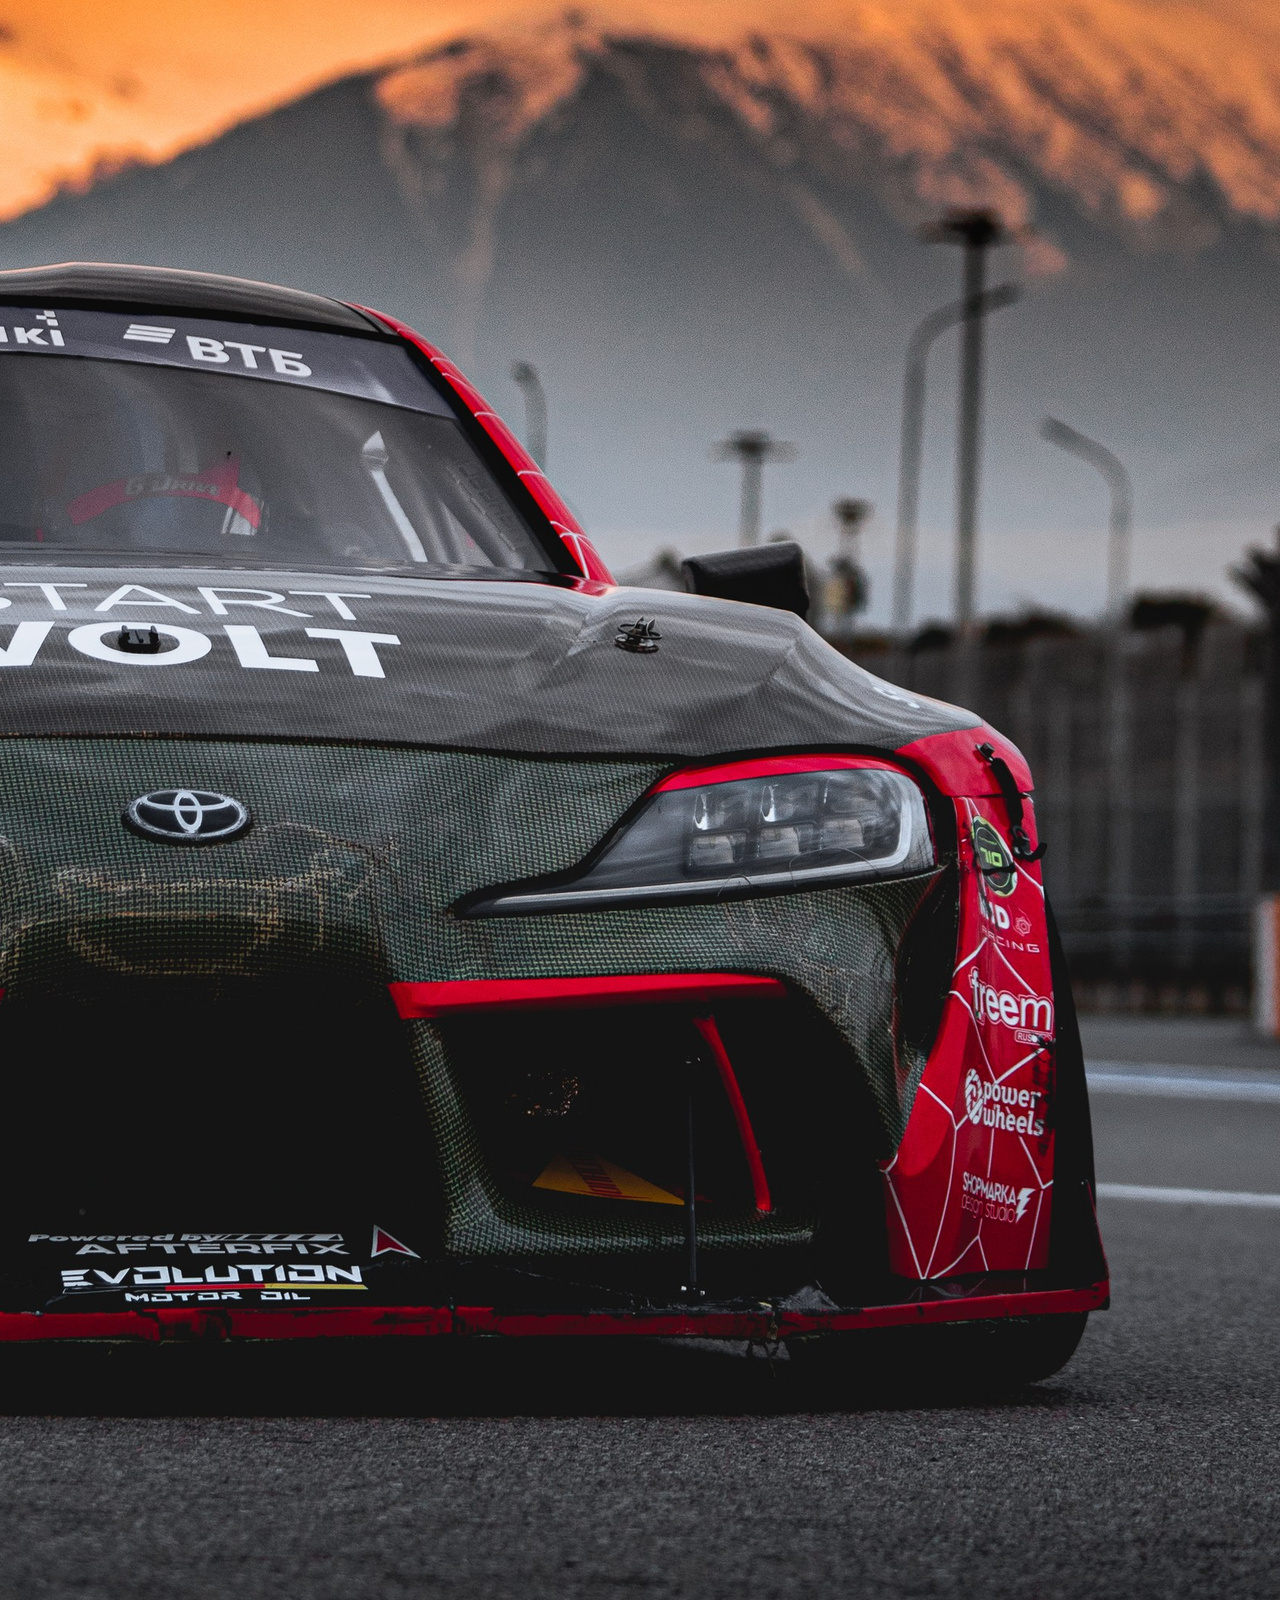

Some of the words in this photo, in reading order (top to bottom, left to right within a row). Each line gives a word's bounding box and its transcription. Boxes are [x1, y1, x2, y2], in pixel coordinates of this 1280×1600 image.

[185, 335, 313, 378] ВТБ
[972, 970, 1052, 1031] freem
[983, 1081, 1042, 1108] power
[983, 1103, 1045, 1136] wheels
[962, 1171, 1017, 1206] SHOPMARKA
[28, 1233, 174, 1242] Powered
[180, 1233, 228, 1243] by
[75, 1243, 350, 1255] AFTERFIX
[60, 1263, 363, 1287] EVOLUTION
[124, 1291, 243, 1302] MOTOR
[260, 1290, 311, 1300] OIL
